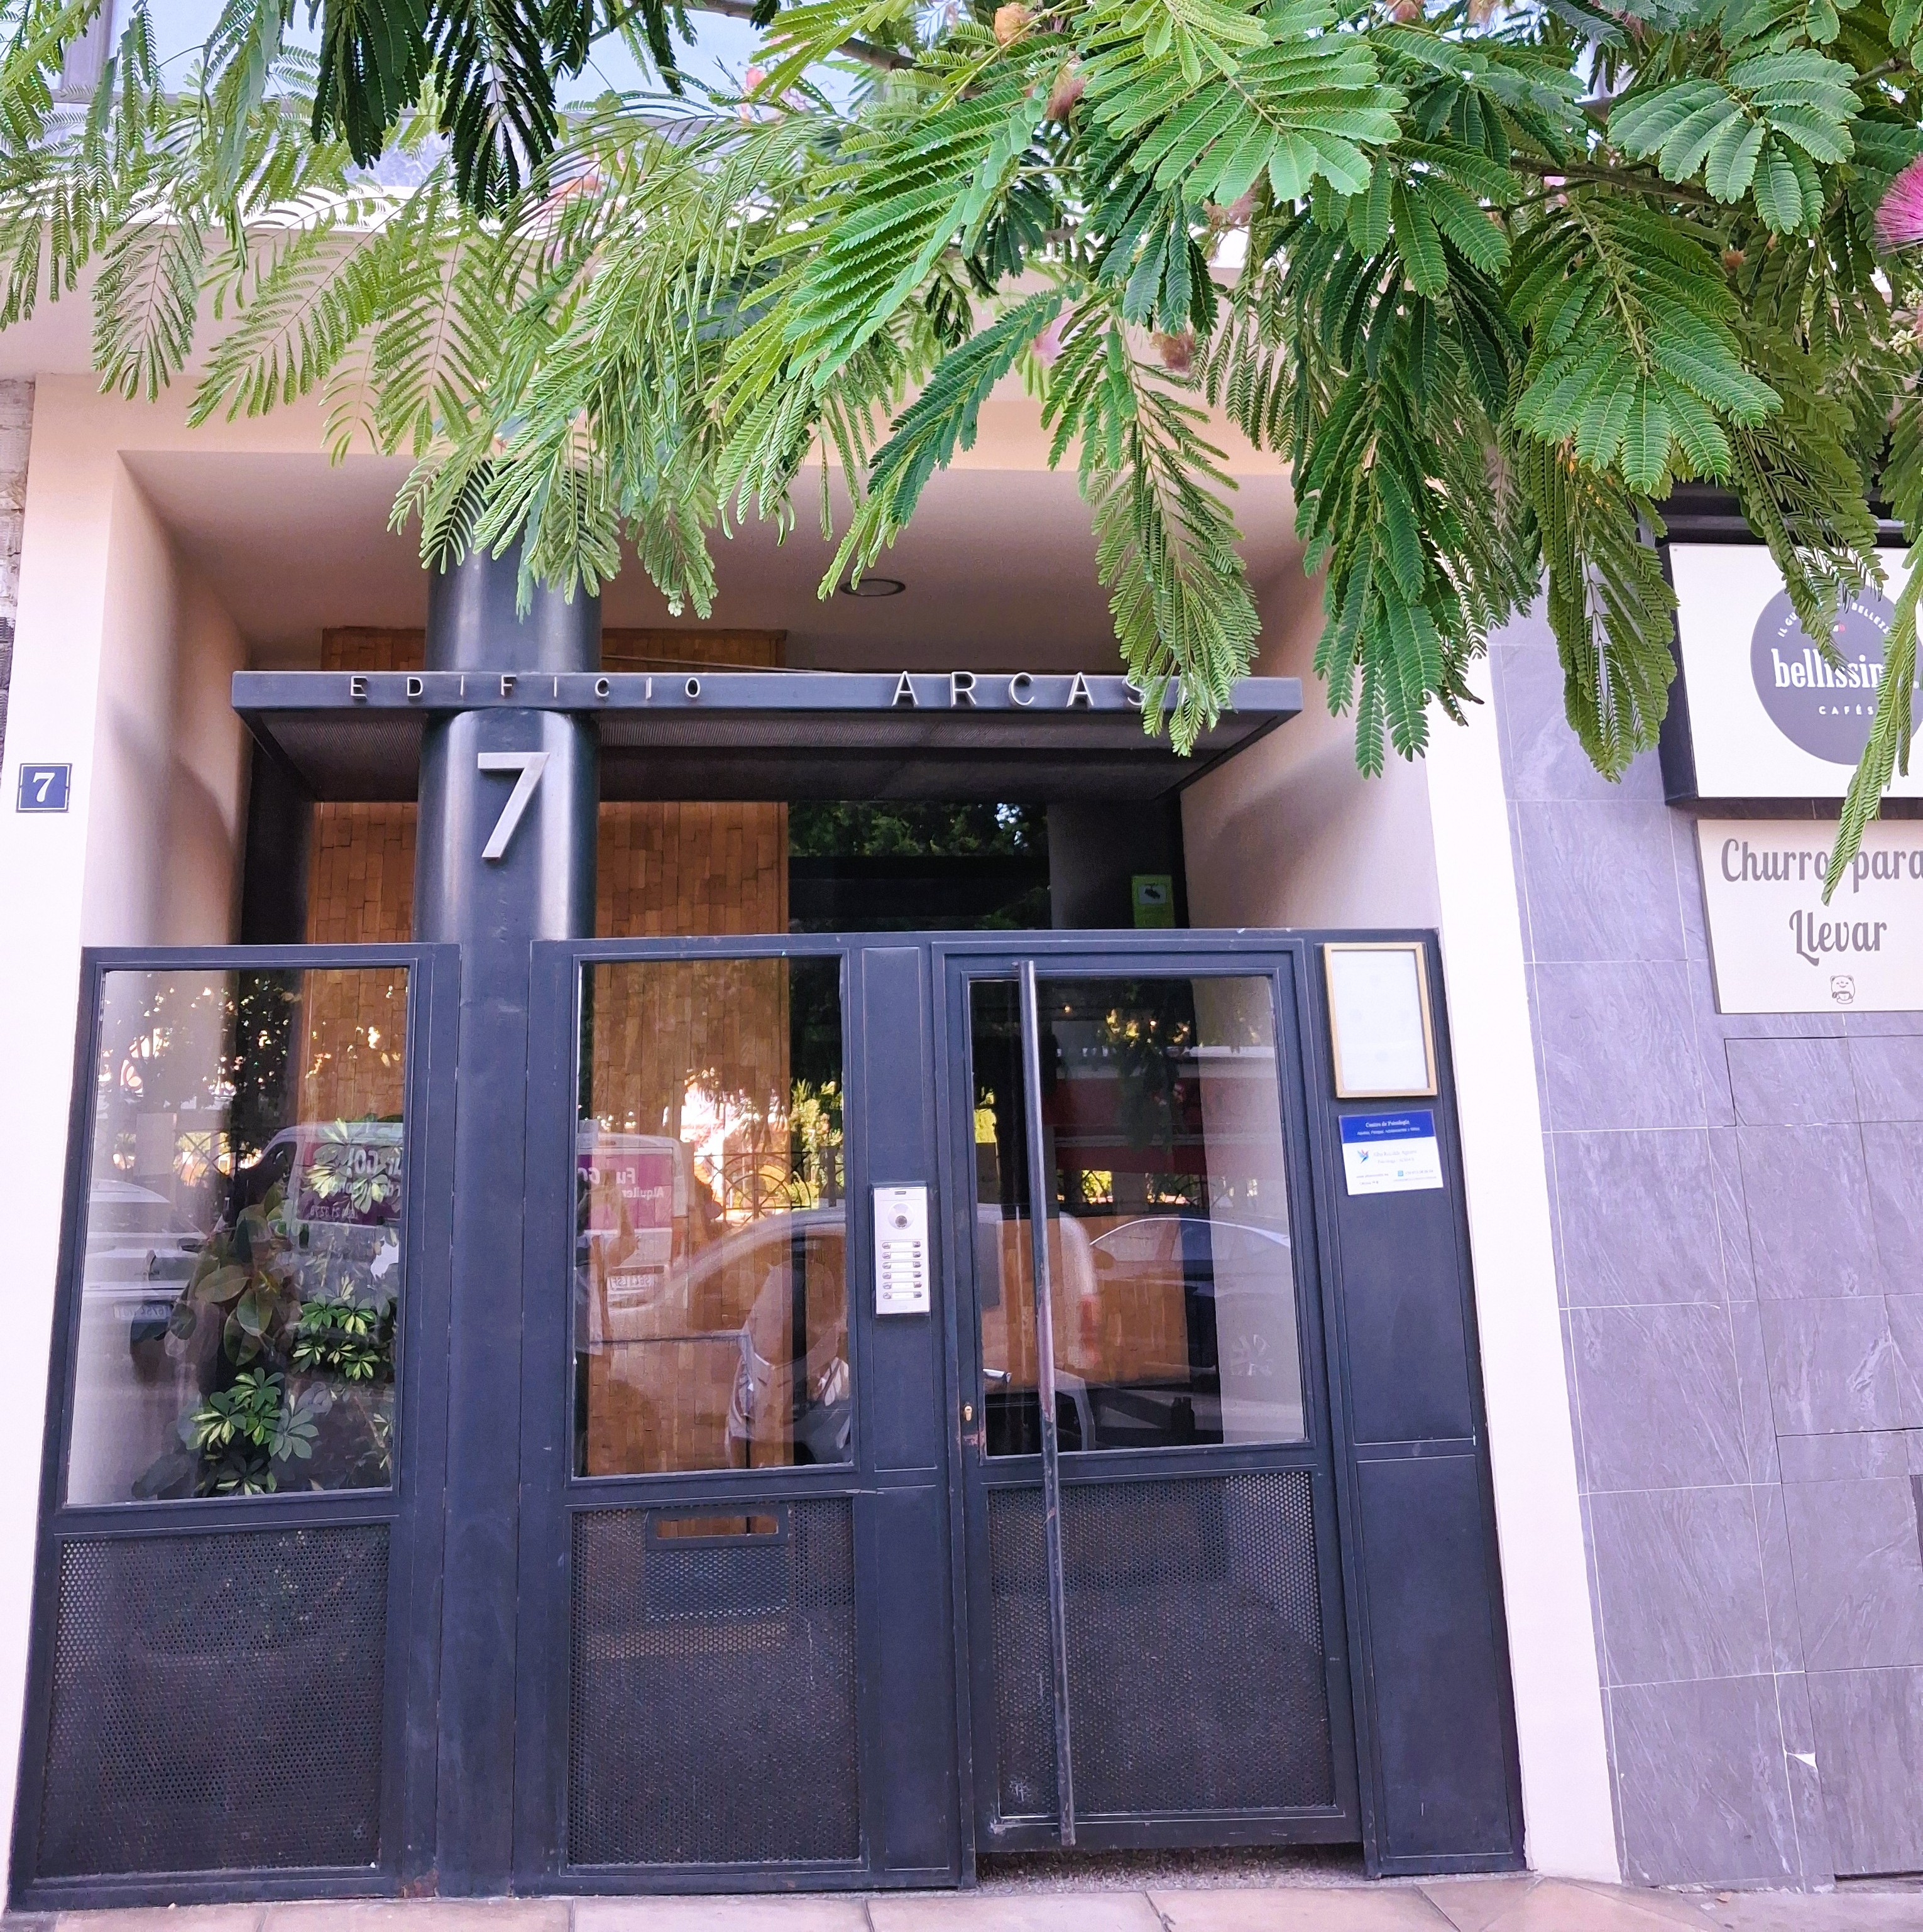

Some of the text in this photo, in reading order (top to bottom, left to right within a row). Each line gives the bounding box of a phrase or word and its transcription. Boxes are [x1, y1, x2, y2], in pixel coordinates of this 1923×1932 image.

[349, 675, 701, 700] EDIFICIO
[32, 772, 56, 803] 7
[478, 751, 551, 860] 7
[1789, 909, 1888, 967] Llevar
